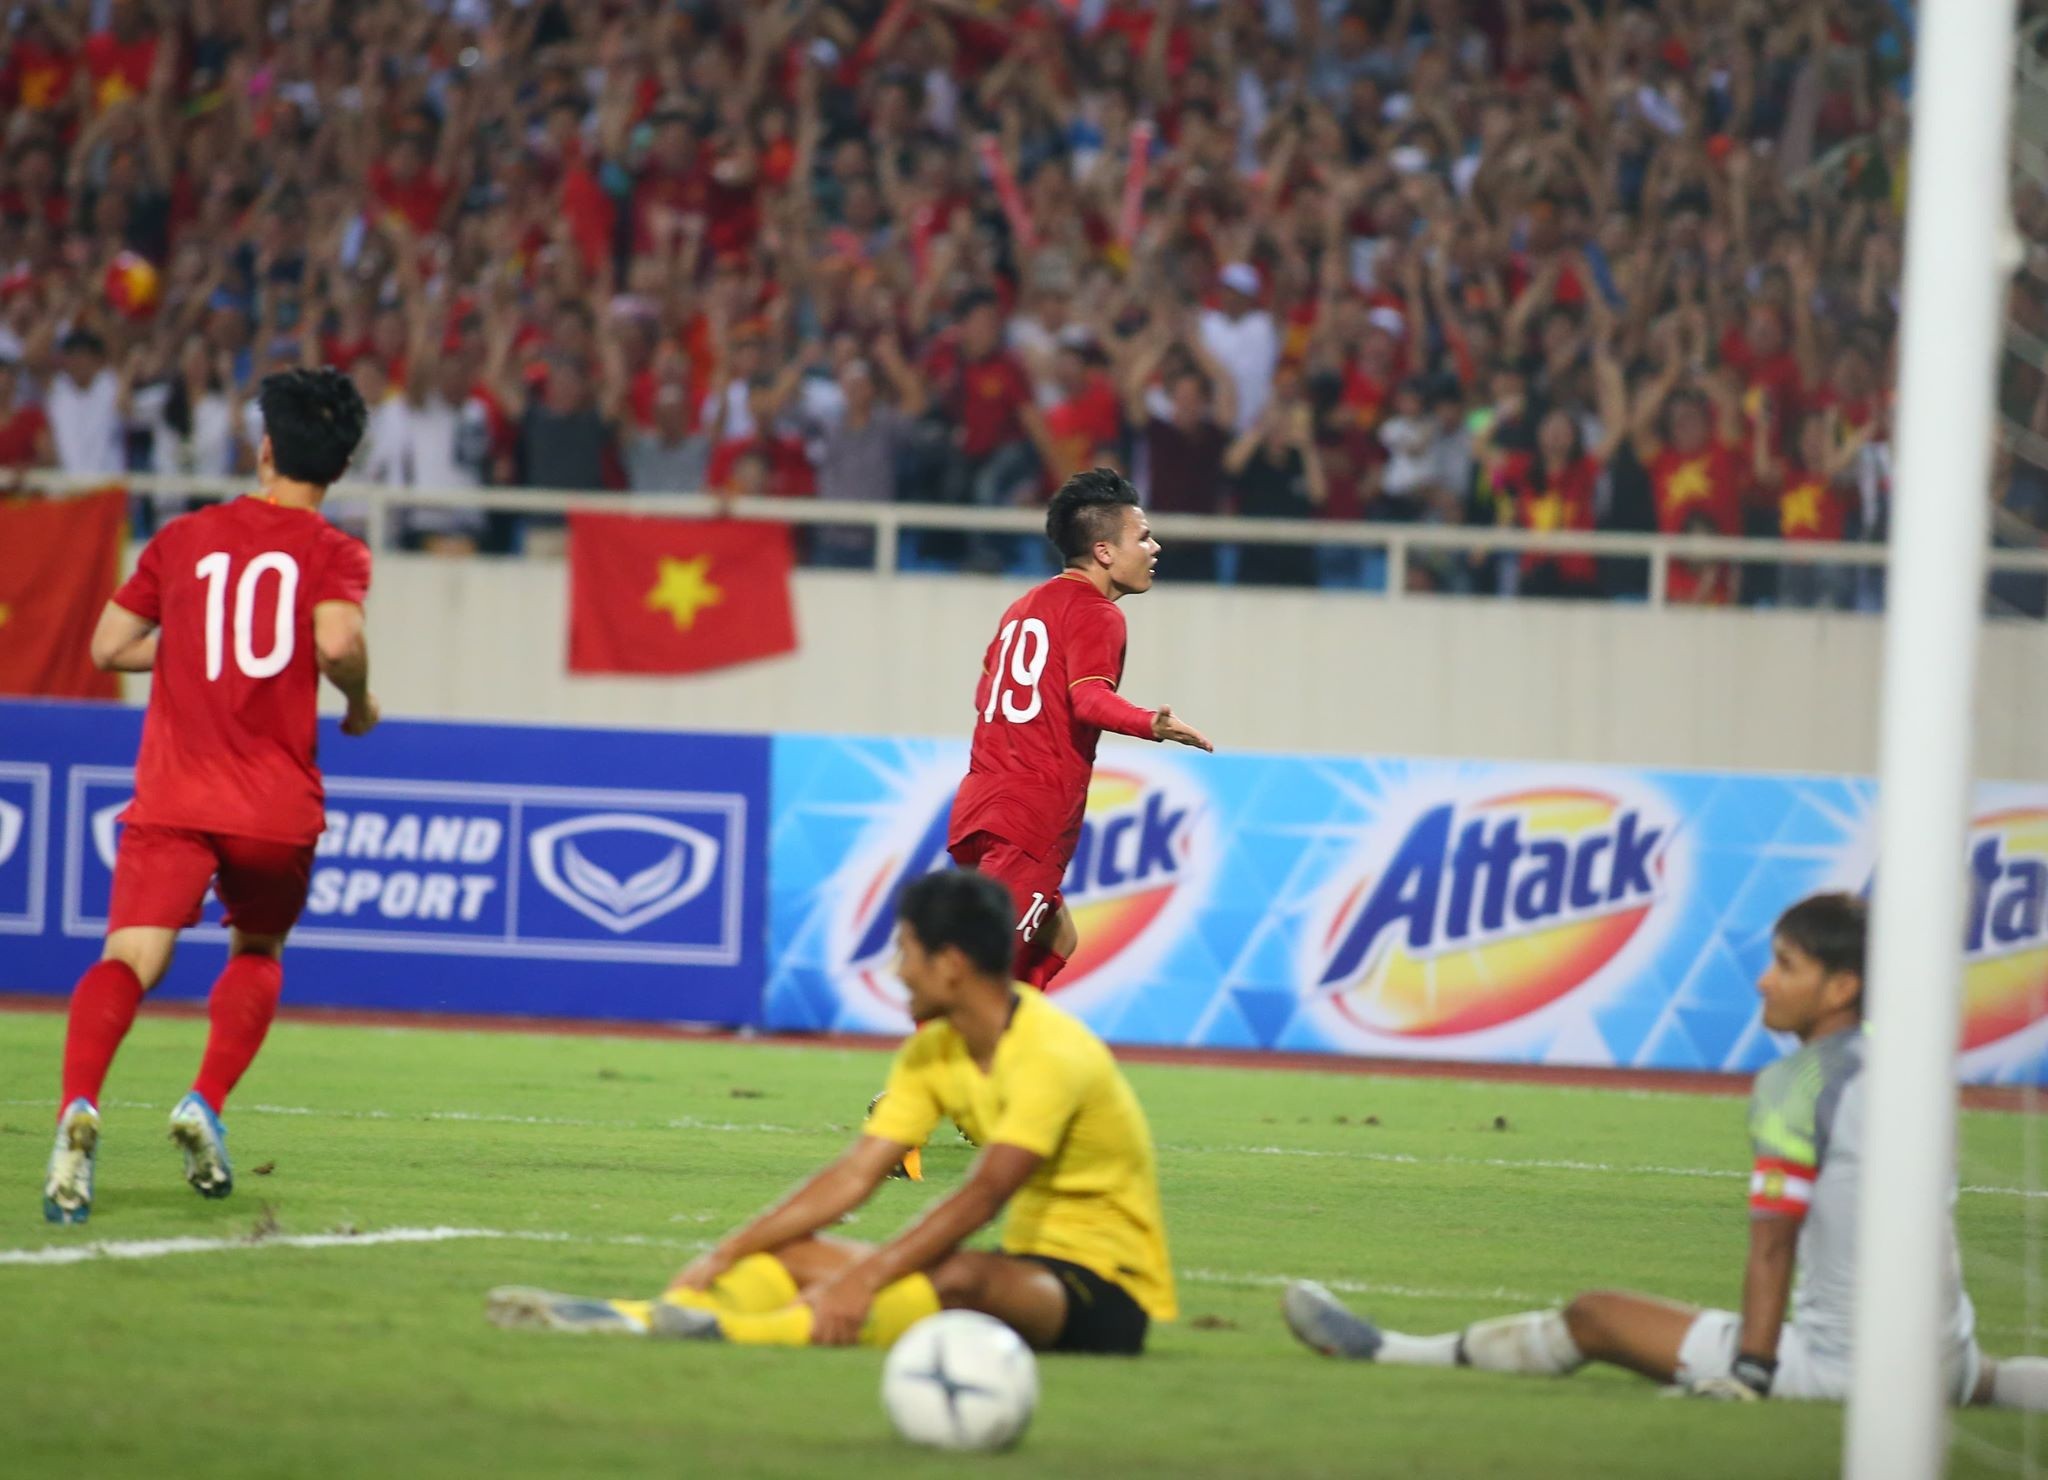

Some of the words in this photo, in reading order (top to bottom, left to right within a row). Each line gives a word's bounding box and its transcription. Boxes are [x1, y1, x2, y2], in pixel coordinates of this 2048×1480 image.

[195, 550, 299, 682] 10
[984, 617, 1049, 723] 19
[315, 809, 502, 863] GRAND
[306, 867, 495, 921] SPORT
[1015, 891, 1049, 942] 19
[1318, 802, 1662, 985] Attack
